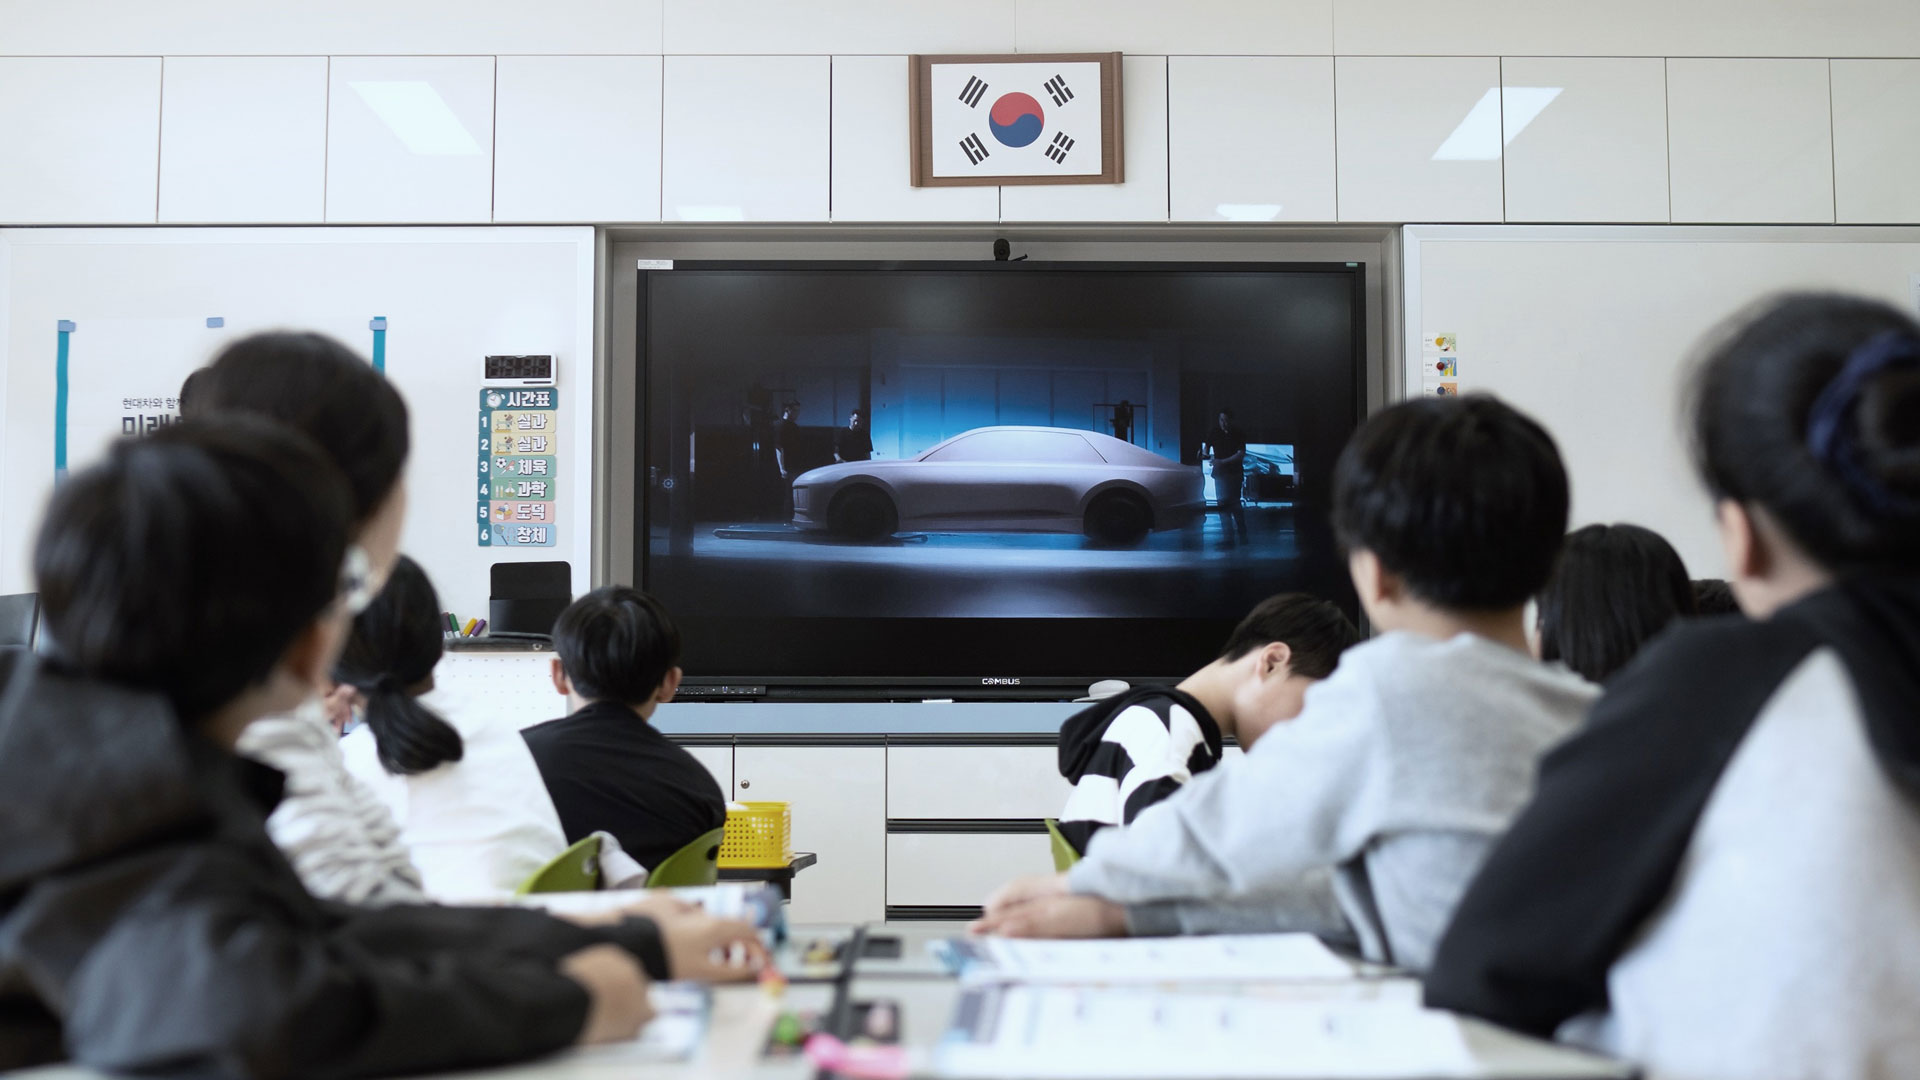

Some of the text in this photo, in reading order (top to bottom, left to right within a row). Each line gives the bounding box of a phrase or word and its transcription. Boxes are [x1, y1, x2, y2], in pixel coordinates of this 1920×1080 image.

[122, 397, 163, 410] 현대차와
[506, 391, 551, 408] 시간표
[122, 414, 182, 437] 미래
[481, 413, 548, 430] 1 실과
[480, 435, 548, 452] 2 실과
[480, 458, 548, 475] 3 체육
[480, 480, 547, 498] 4 과학
[479, 503, 545, 520] 5 도덕
[480, 526, 547, 543] 6 창체
